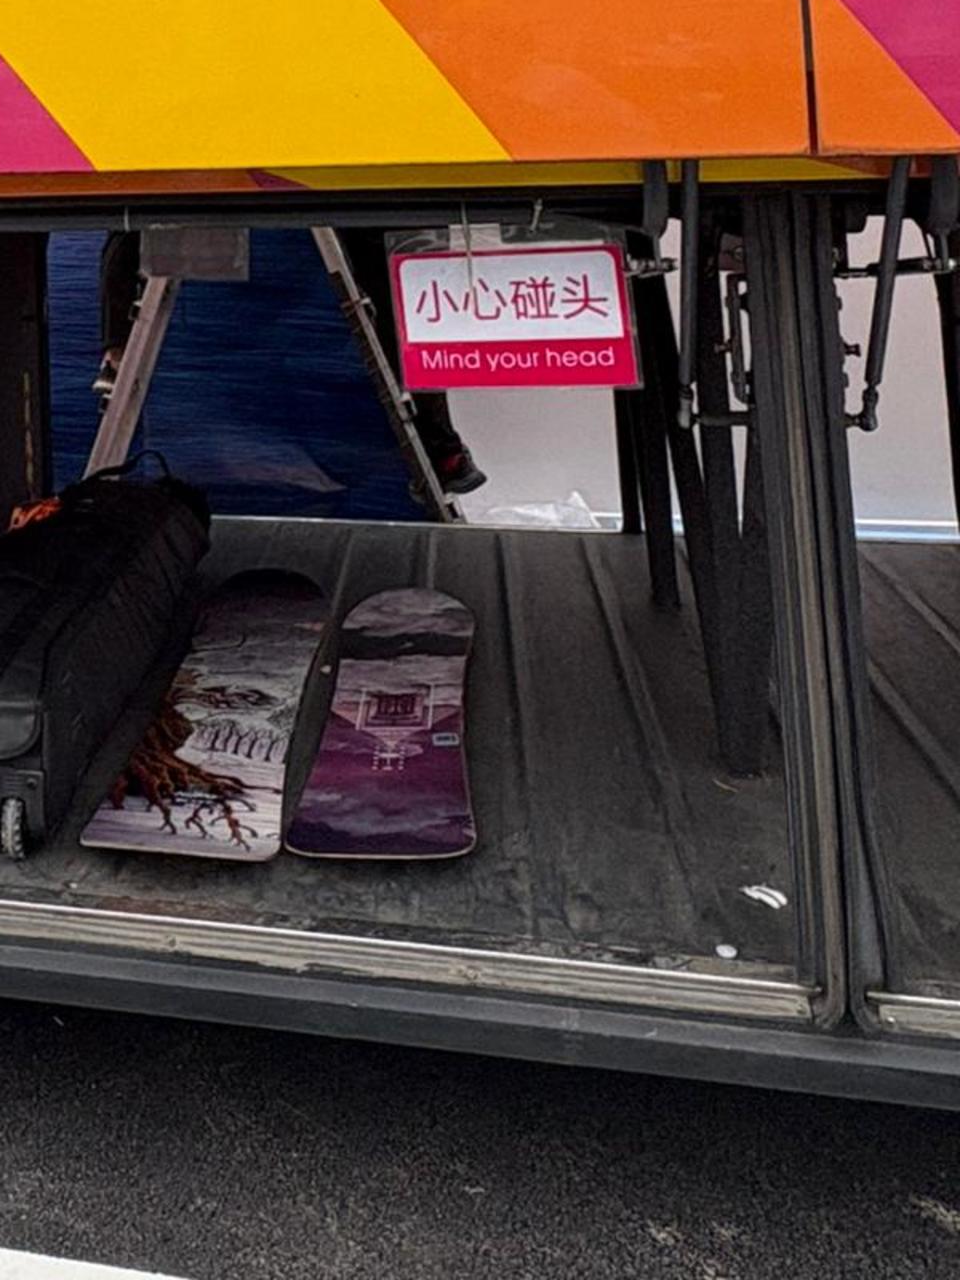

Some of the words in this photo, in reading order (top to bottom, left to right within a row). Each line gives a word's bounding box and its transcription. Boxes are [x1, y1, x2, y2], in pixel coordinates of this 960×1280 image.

[415, 274, 609, 322] 小心碰头
[421, 349, 481, 369] Mind
[486, 352, 539, 372] your
[546, 347, 615, 367] head
